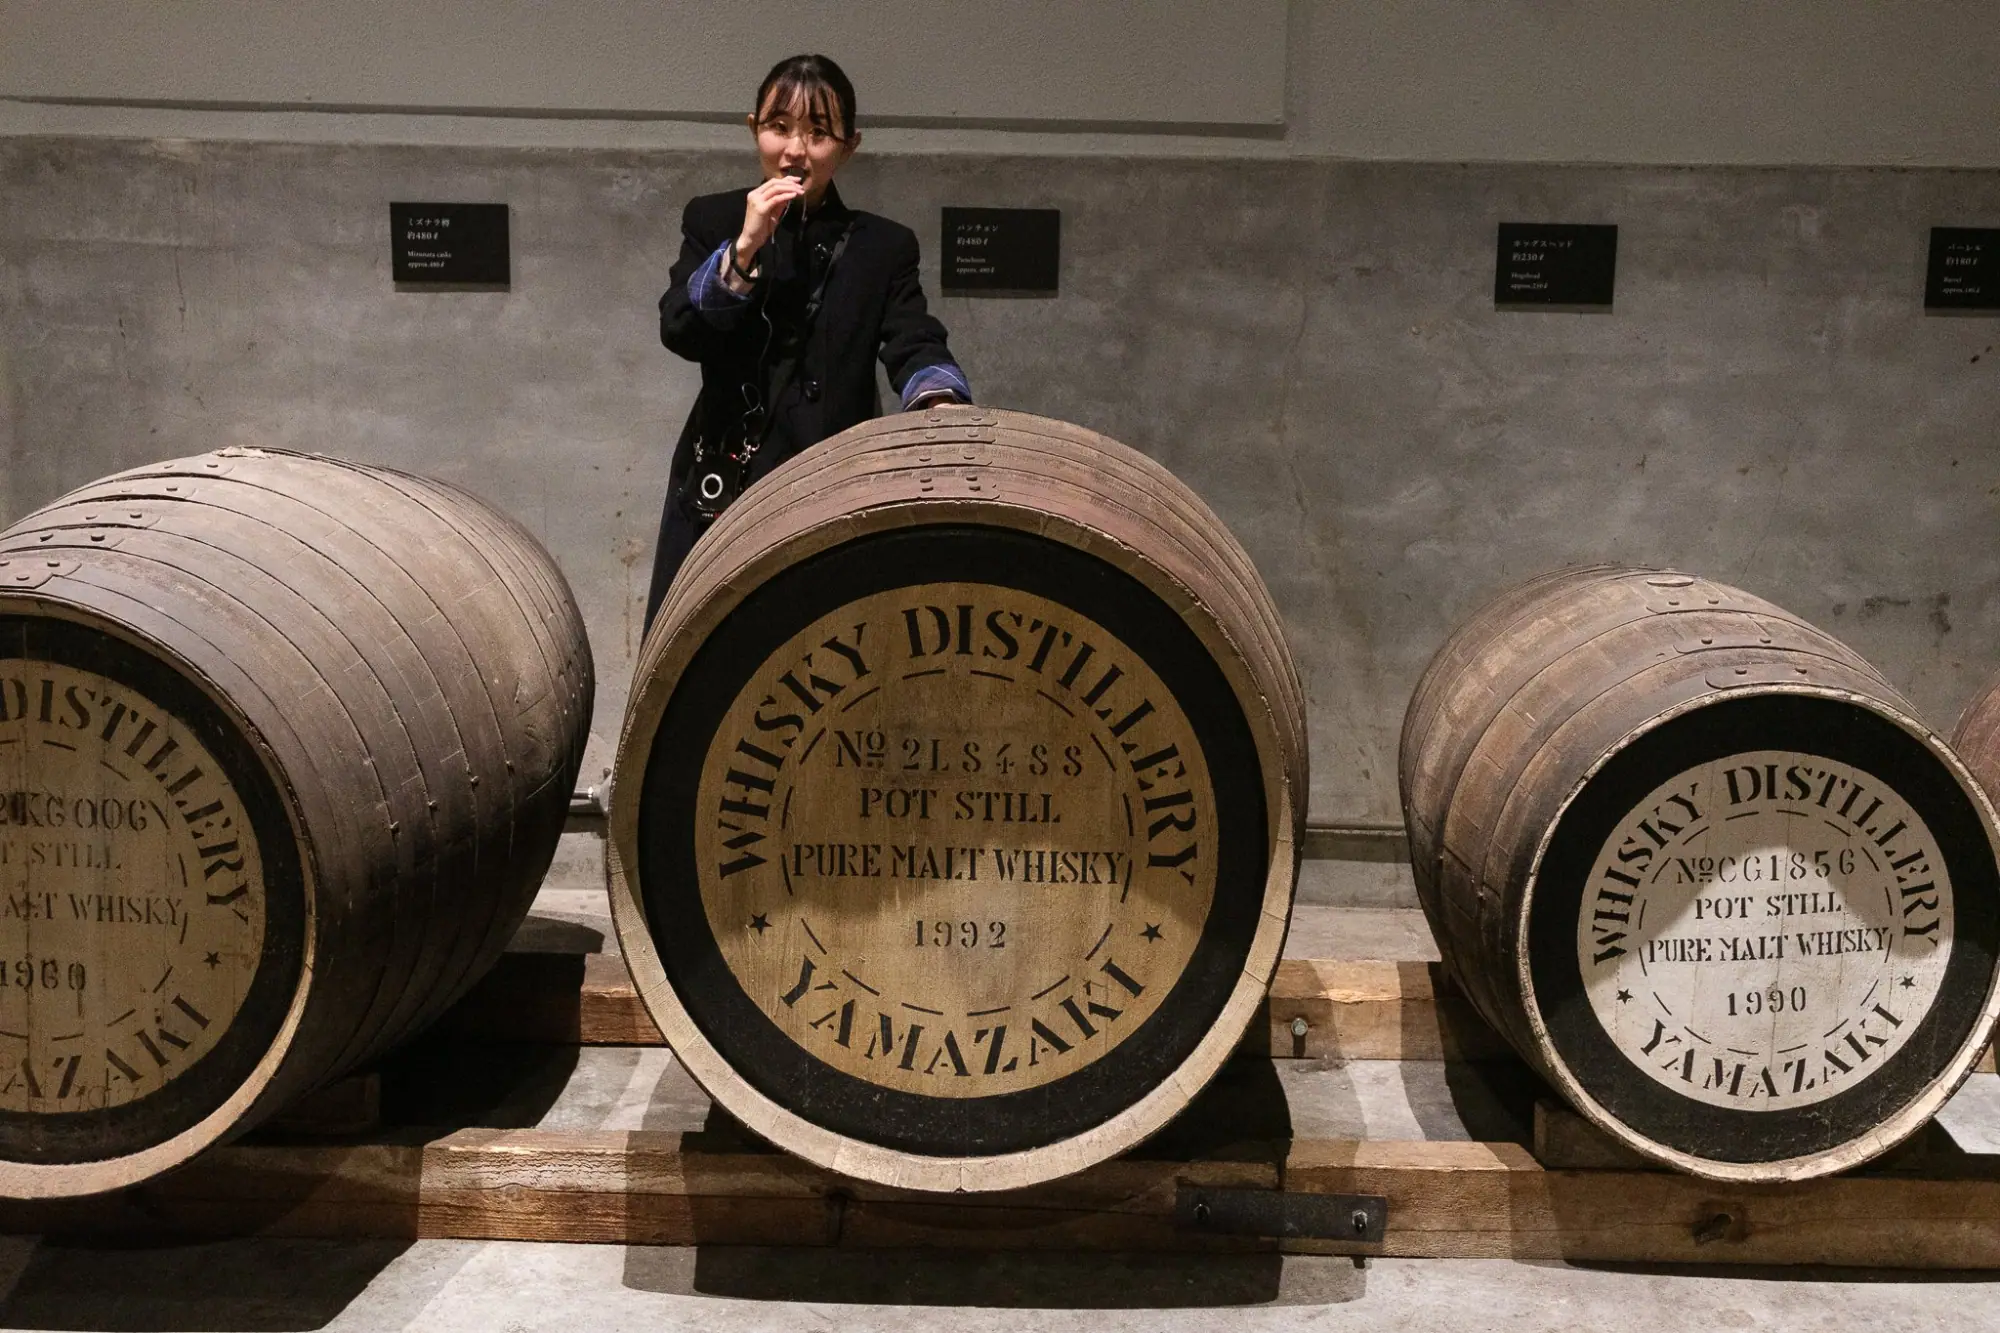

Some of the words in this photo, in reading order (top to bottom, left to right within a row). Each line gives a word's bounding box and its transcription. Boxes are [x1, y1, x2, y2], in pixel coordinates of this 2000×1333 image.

[719, 622, 872, 880] WHISKY
[902, 604, 1198, 886] DISTILLERY
[859, 788, 938, 821] POT
[954, 791, 1061, 824] STILL
[32, 842, 121, 869] STILL
[792, 844, 882, 878] PURE
[891, 845, 988, 882] MALT
[993, 849, 1127, 885] WHISKY
[1592, 782, 1704, 965] WHISKY
[1724, 764, 1941, 947] DISTILLERY
[68, 893, 182, 926] WHISKY
[1695, 897, 1753, 920] POT
[1766, 891, 1843, 917] STILL
[914, 920, 1008, 949] 1992
[1648, 938, 1712, 963] PURE
[1720, 934, 1789, 961] MALT
[1798, 927, 1890, 957] WHISKY
[780, 954, 1147, 1078] YAMAZAKI
[1727, 986, 1808, 1016] 1990
[1640, 1001, 1904, 1100] YAMAZAKI
